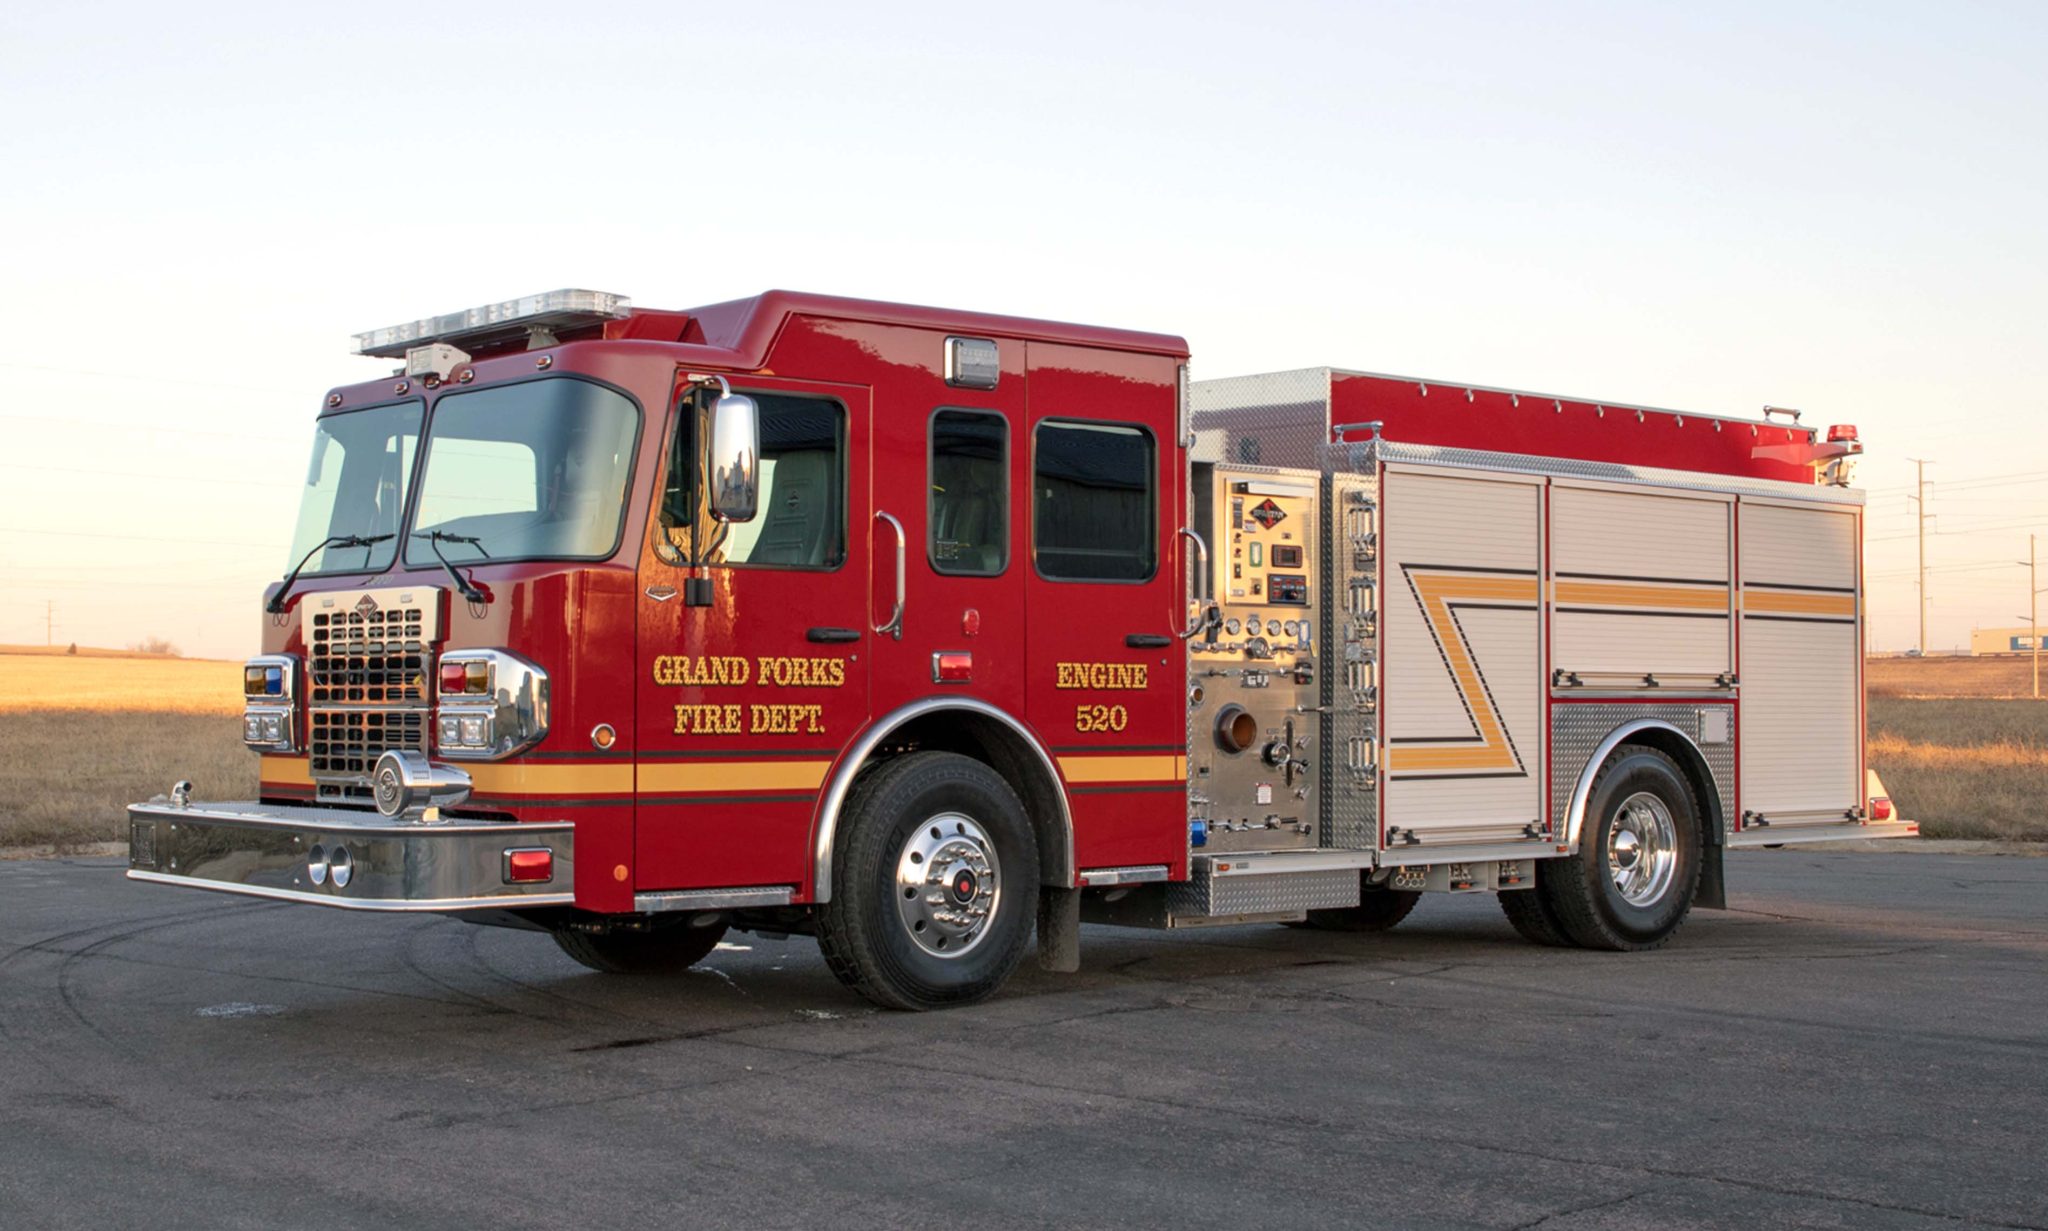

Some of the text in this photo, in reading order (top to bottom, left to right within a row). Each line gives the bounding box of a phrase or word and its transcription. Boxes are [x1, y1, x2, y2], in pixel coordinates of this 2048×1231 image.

[653, 655, 846, 687] GRAND FORKS
[1056, 662, 1148, 690] ENGINE
[673, 704, 826, 735] FIRE DEPT.
[1076, 704, 1128, 732] 520
